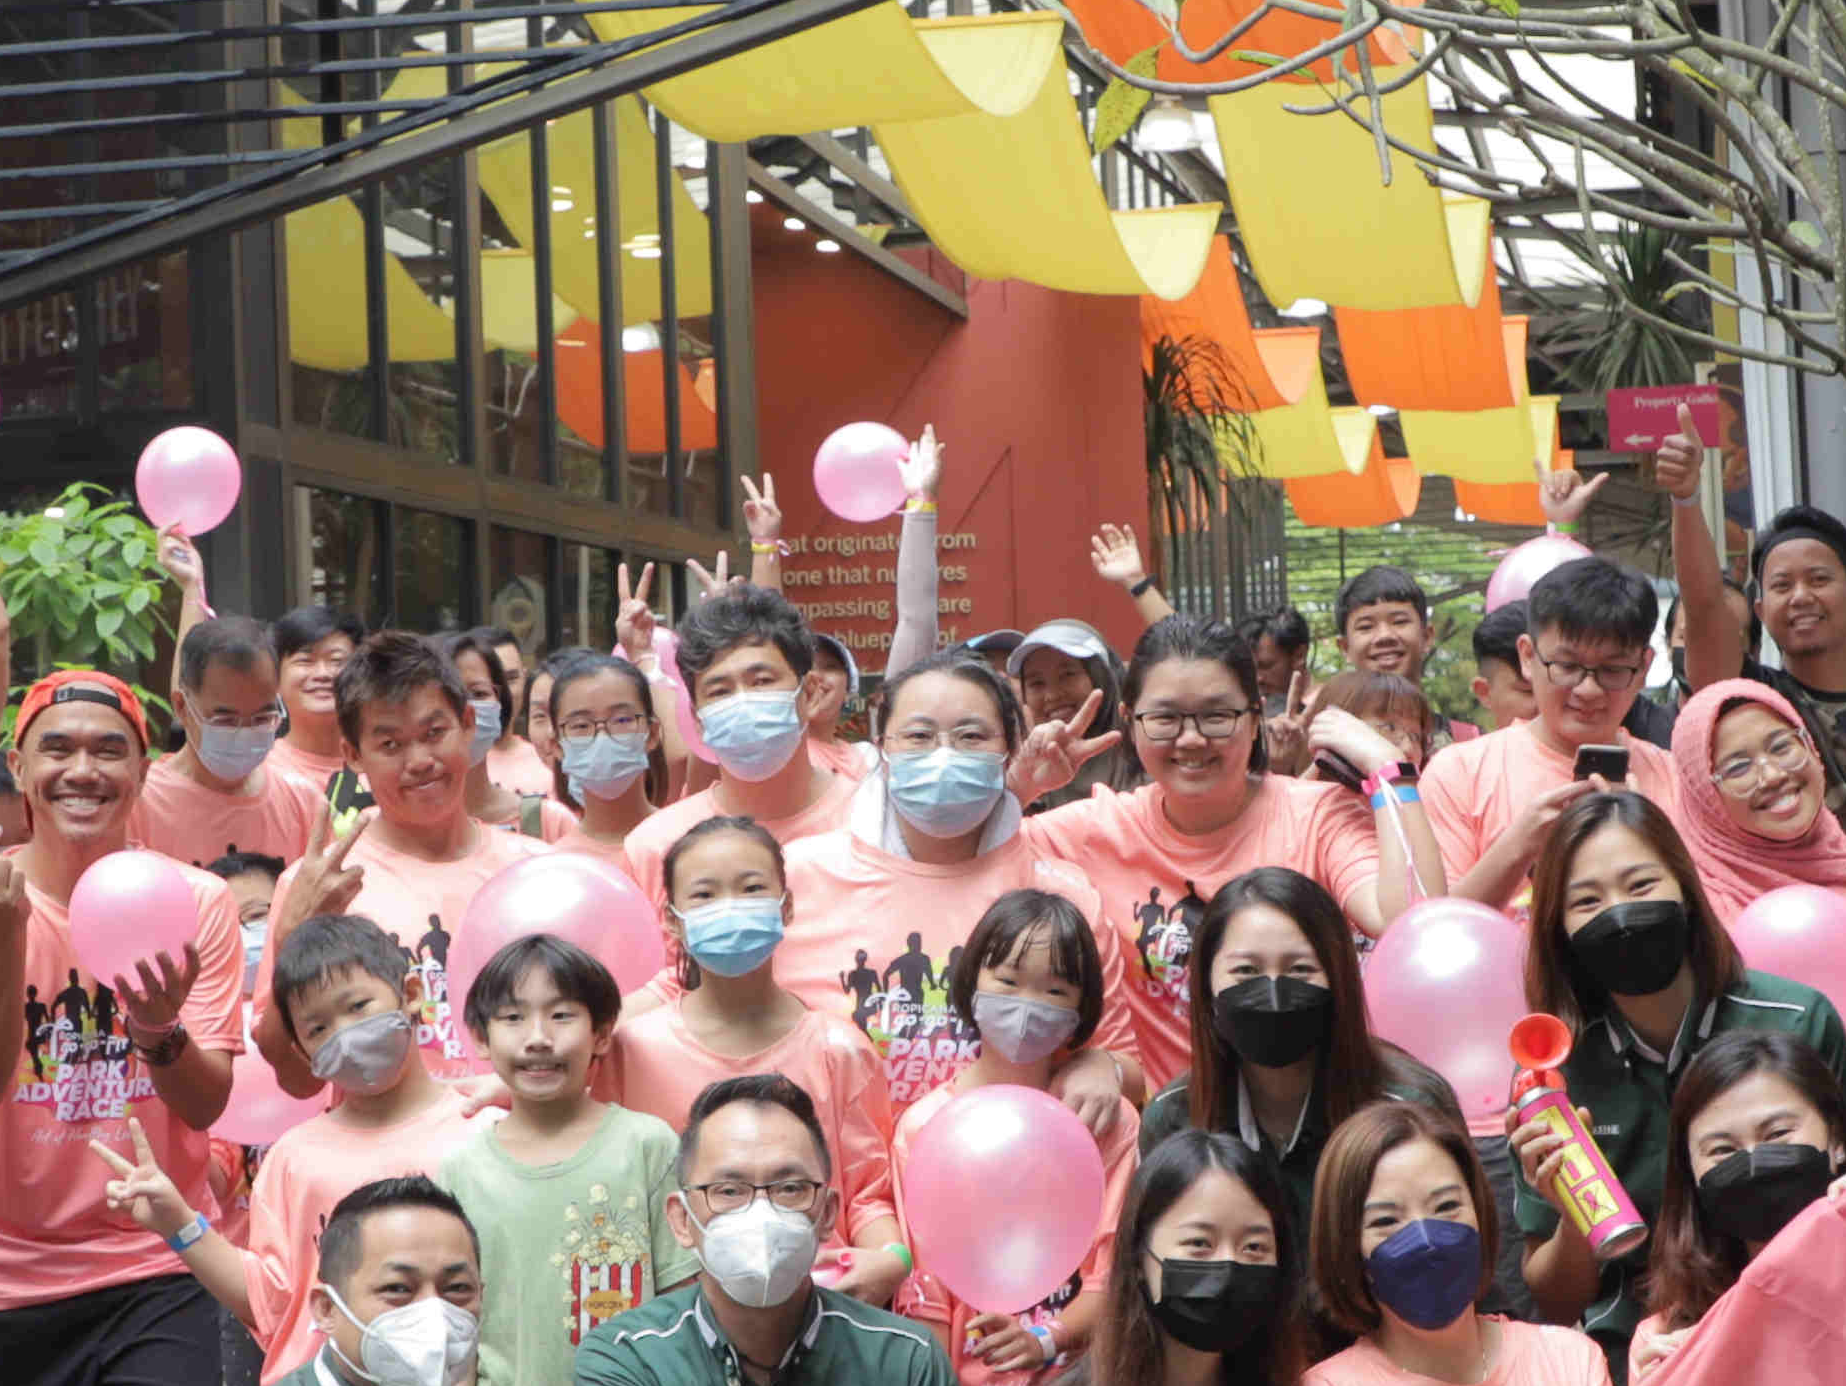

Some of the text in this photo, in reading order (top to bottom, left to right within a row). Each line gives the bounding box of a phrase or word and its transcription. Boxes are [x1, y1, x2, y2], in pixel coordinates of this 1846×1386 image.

[813, 534, 900, 556] originat
[933, 533, 976, 549] rom
[826, 568, 871, 585] that
[887, 1037, 983, 1062] PARK
[55, 1059, 128, 1083] PARK
[13, 1077, 158, 1103] ADVENTUR
[55, 1098, 129, 1122] RACE
